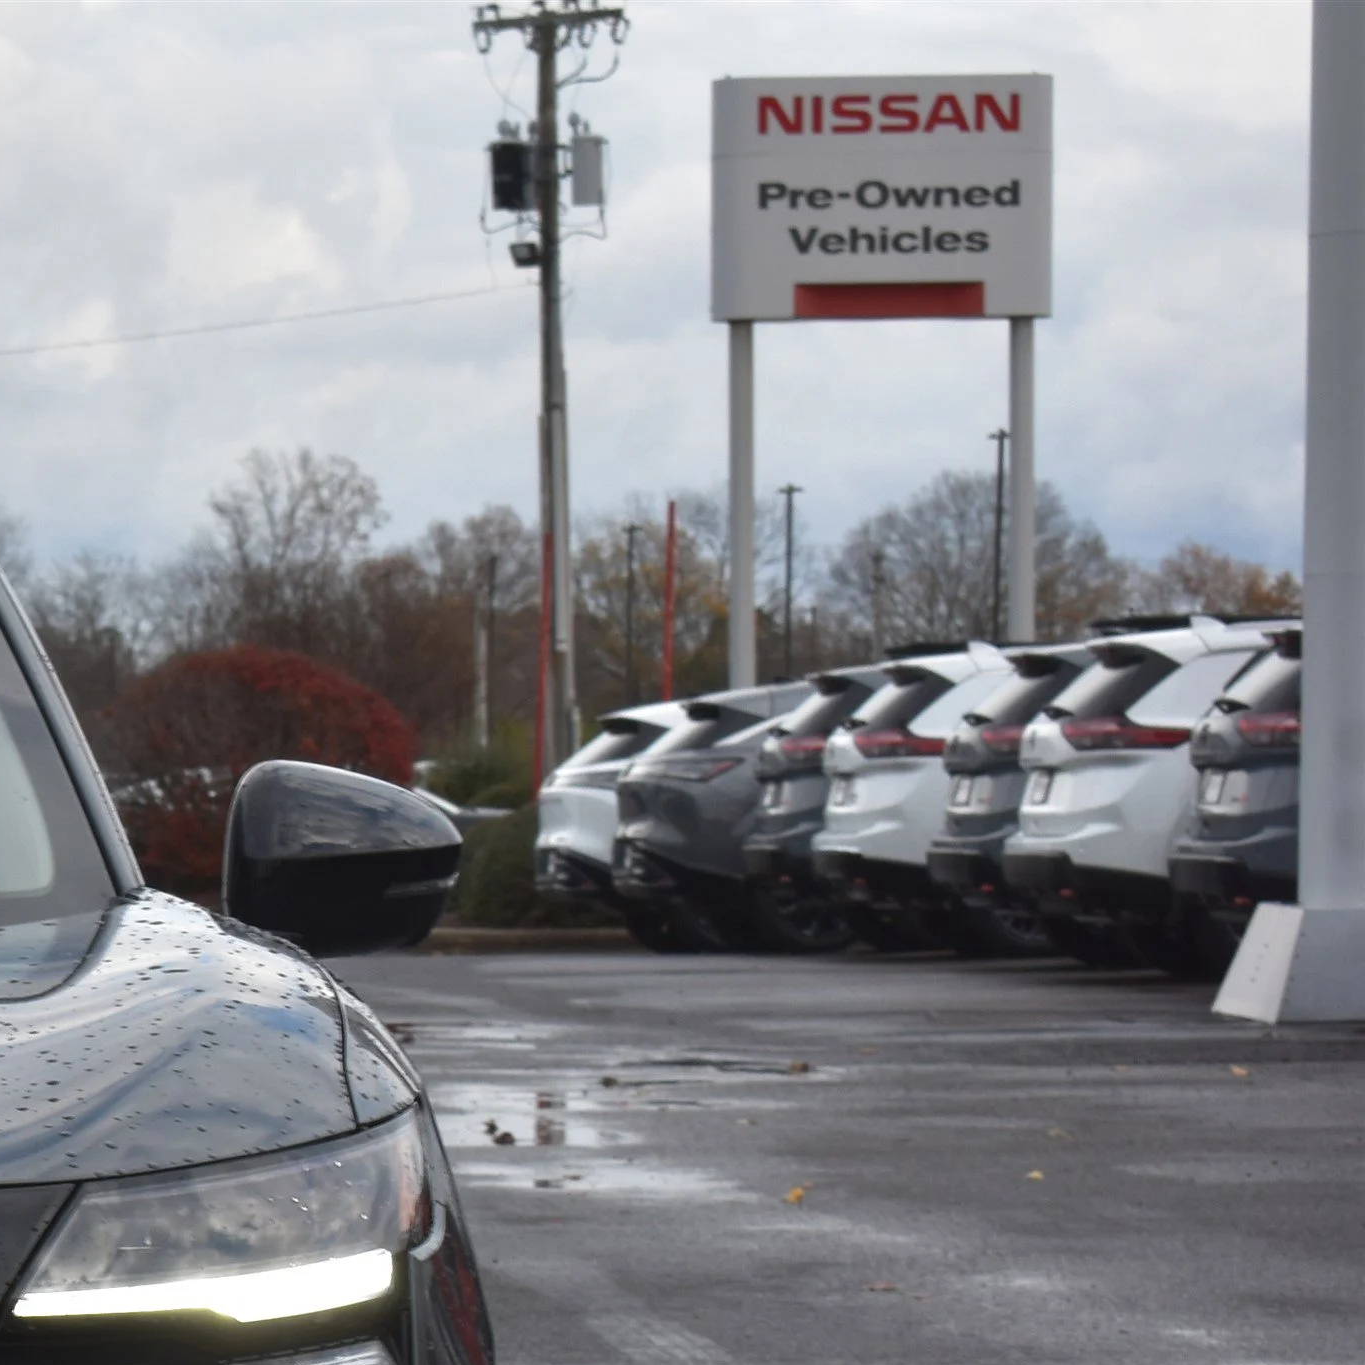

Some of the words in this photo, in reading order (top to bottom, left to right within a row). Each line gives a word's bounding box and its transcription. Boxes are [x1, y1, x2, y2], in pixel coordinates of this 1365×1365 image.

[757, 92, 1021, 135] NISSAN
[757, 179, 1021, 211] Pre-Owned
[788, 225, 990, 255] Vehicles
